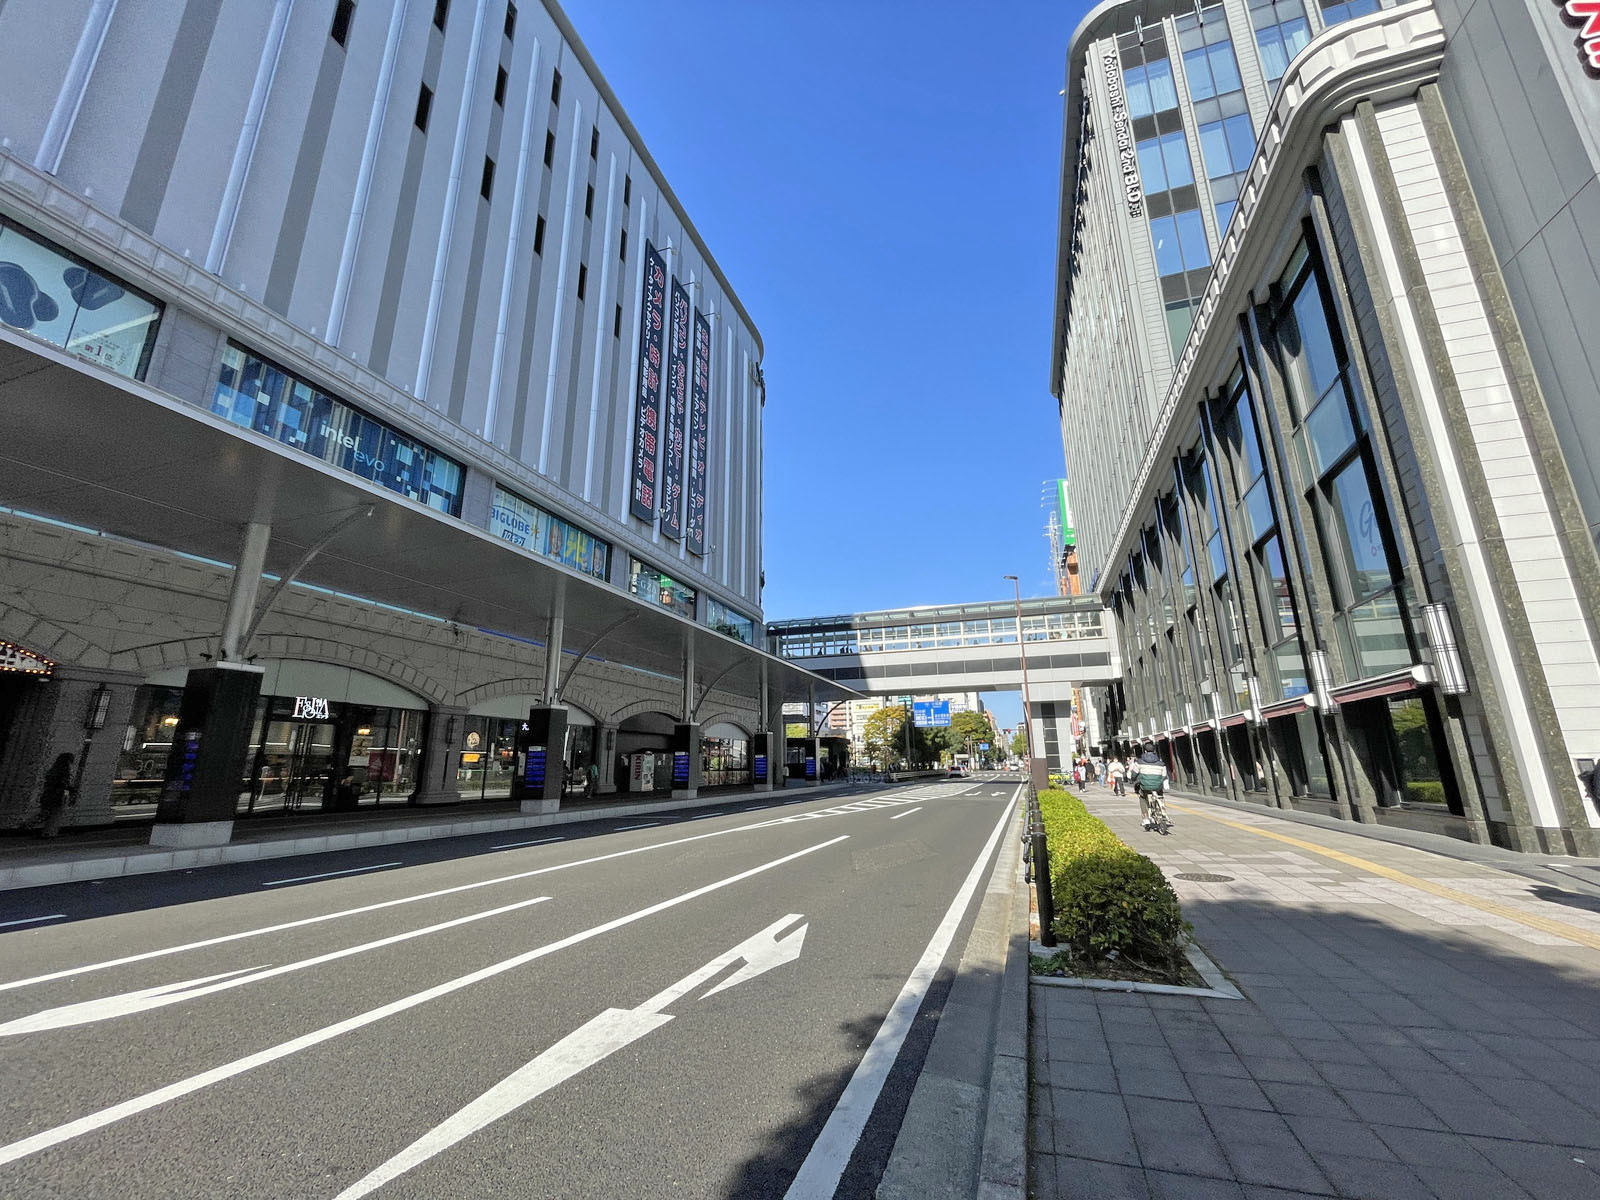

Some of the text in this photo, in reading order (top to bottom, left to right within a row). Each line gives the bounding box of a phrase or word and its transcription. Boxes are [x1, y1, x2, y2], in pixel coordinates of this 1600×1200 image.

[1121, 149, 1136, 173] 2nd
[320, 421, 360, 452] intel
[354, 451, 385, 471] evo
